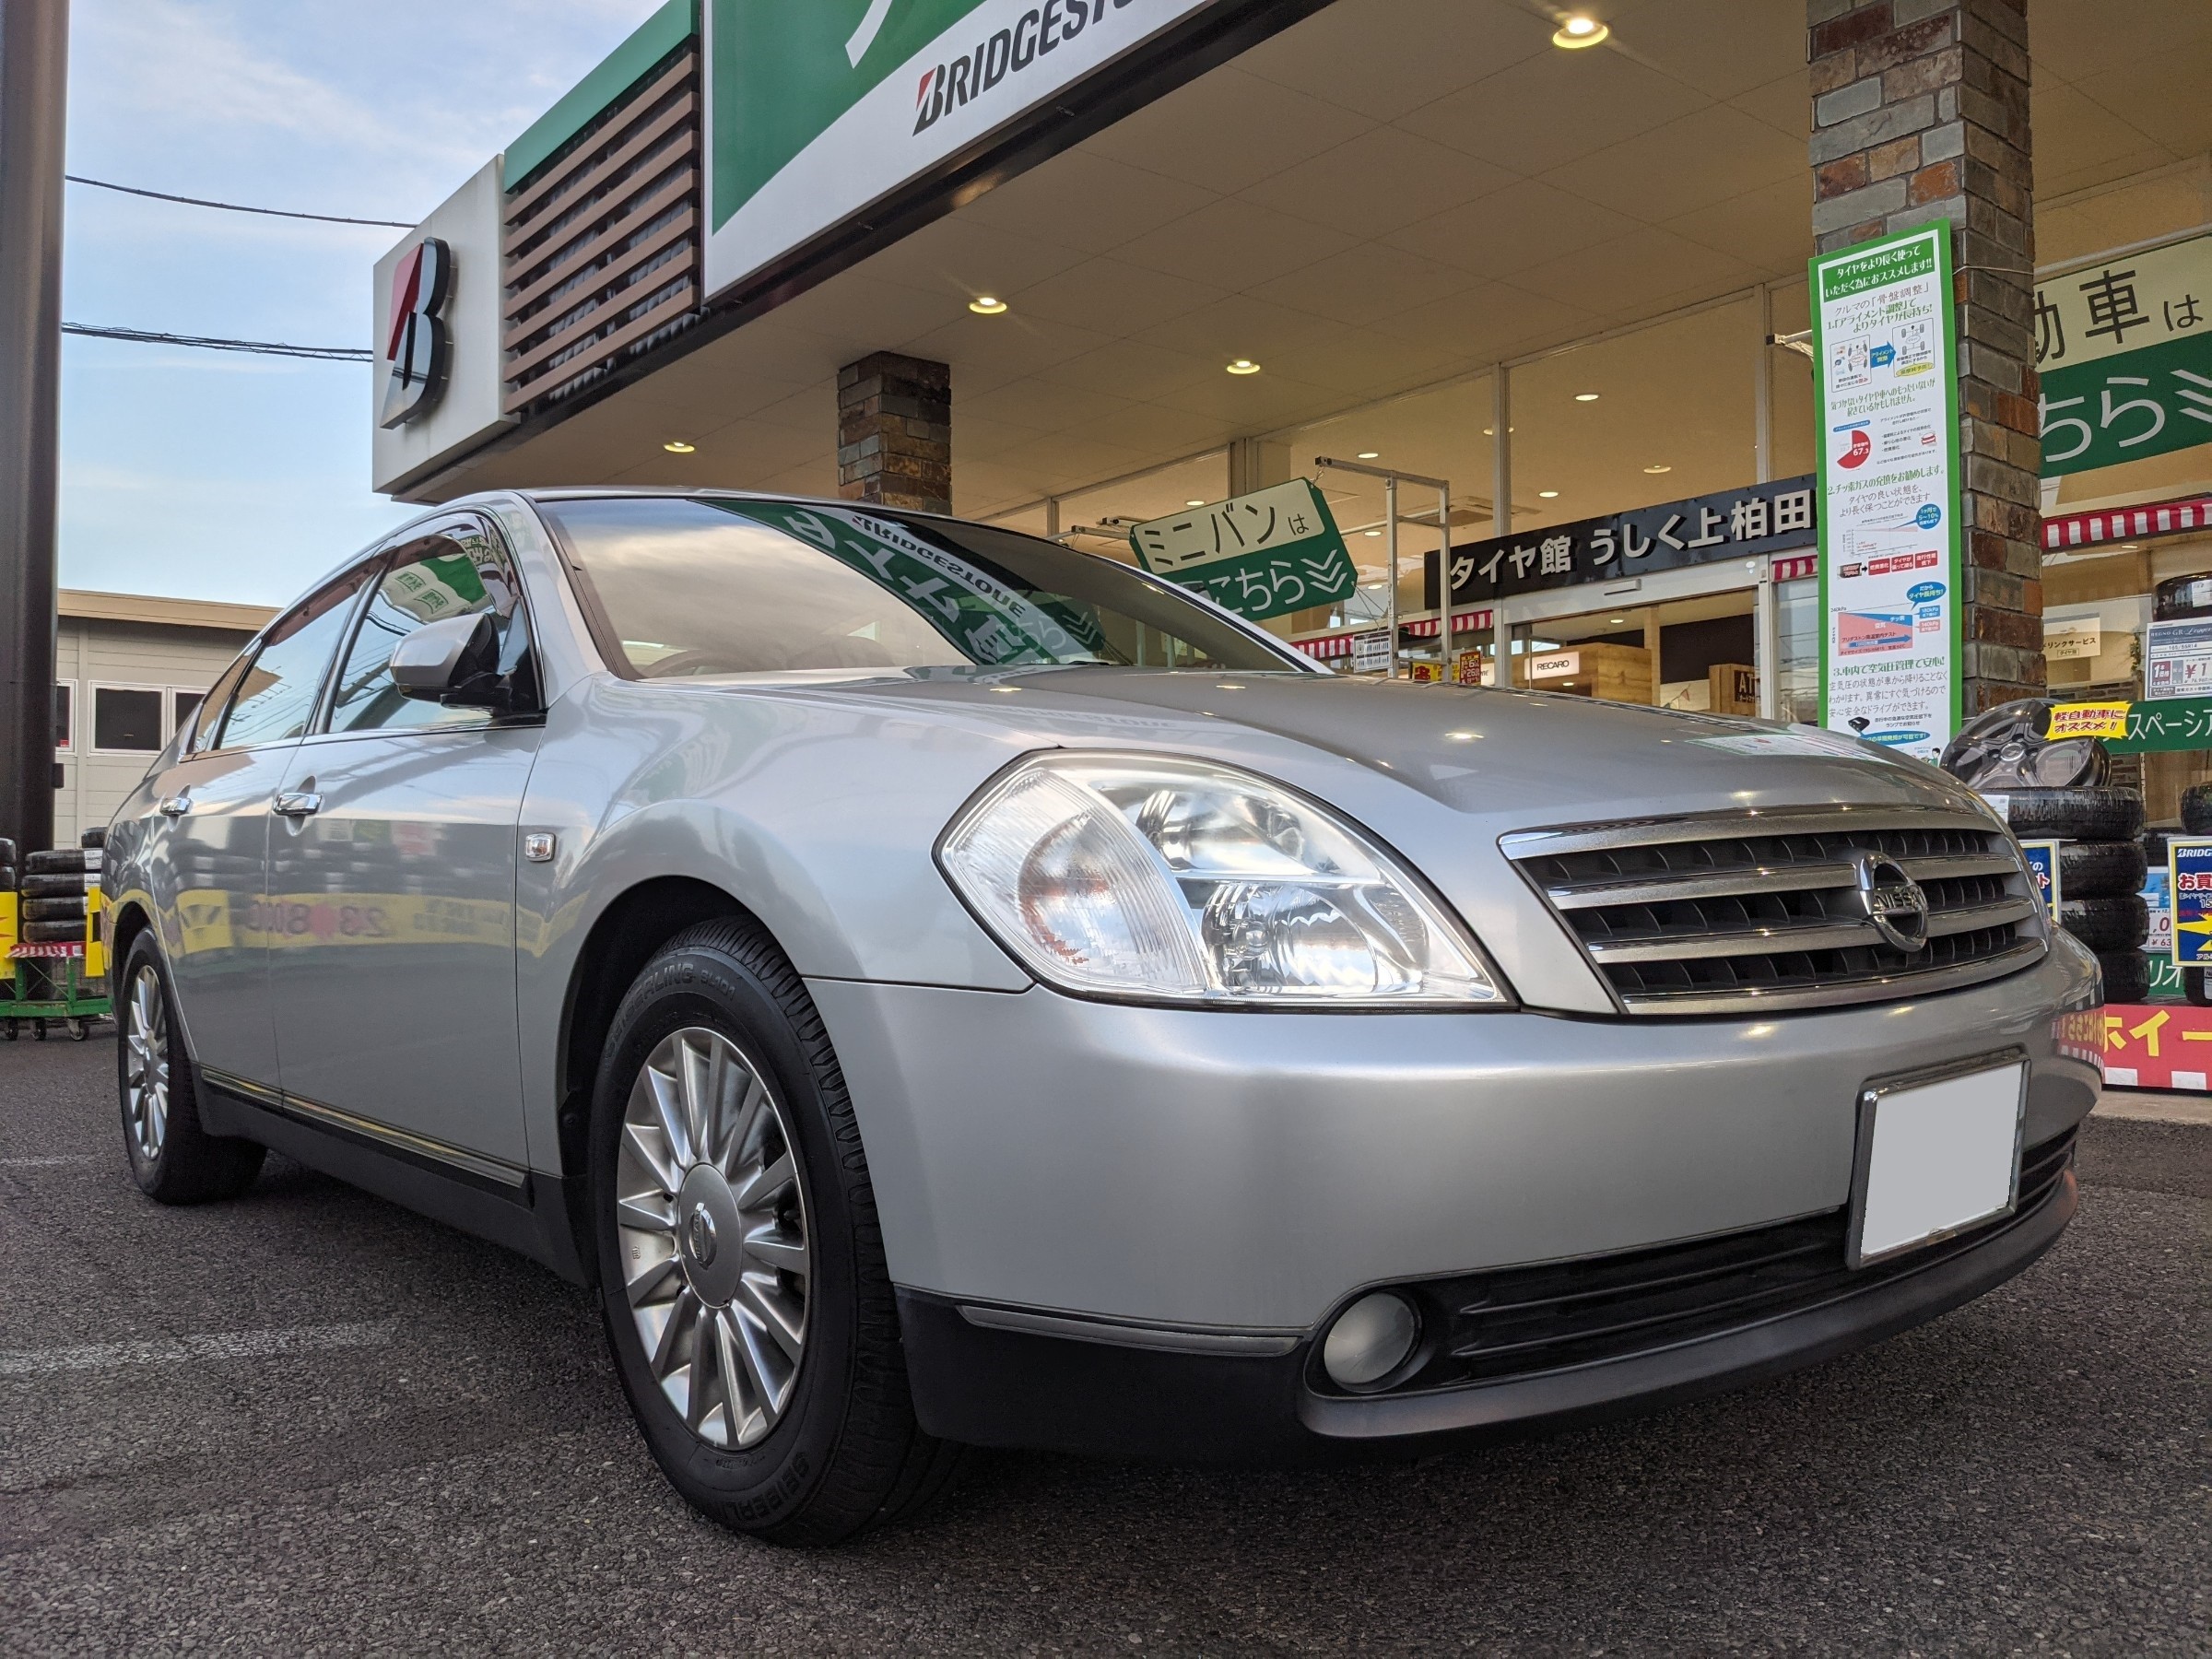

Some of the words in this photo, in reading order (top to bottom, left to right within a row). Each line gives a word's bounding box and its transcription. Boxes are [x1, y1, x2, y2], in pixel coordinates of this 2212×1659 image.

[1837, 245, 1921, 278] タイヤをより長く使って
[1835, 282, 1929, 316] クルマの「骨盤調整」
[1840, 492, 1931, 518] より長く保つことができます
[1849, 484, 1922, 505] タイヤの良い状態を、
[1450, 535, 1571, 591] タイヤ館
[1590, 489, 1812, 565] うしく上柏田
[1536, 660, 1570, 671] RECARO
[1833, 656, 1945, 677] 3.車内で空気圧管理で安心!
[1829, 671, 1947, 691] 空気圧の状態が車から降りることなく
[1829, 686, 1947, 704] わかります。異常にすぐ気づけるので
[1829, 700, 1929, 718] 安心安全なドライブができます。
[2054, 709, 2125, 722] 軽自動車に
